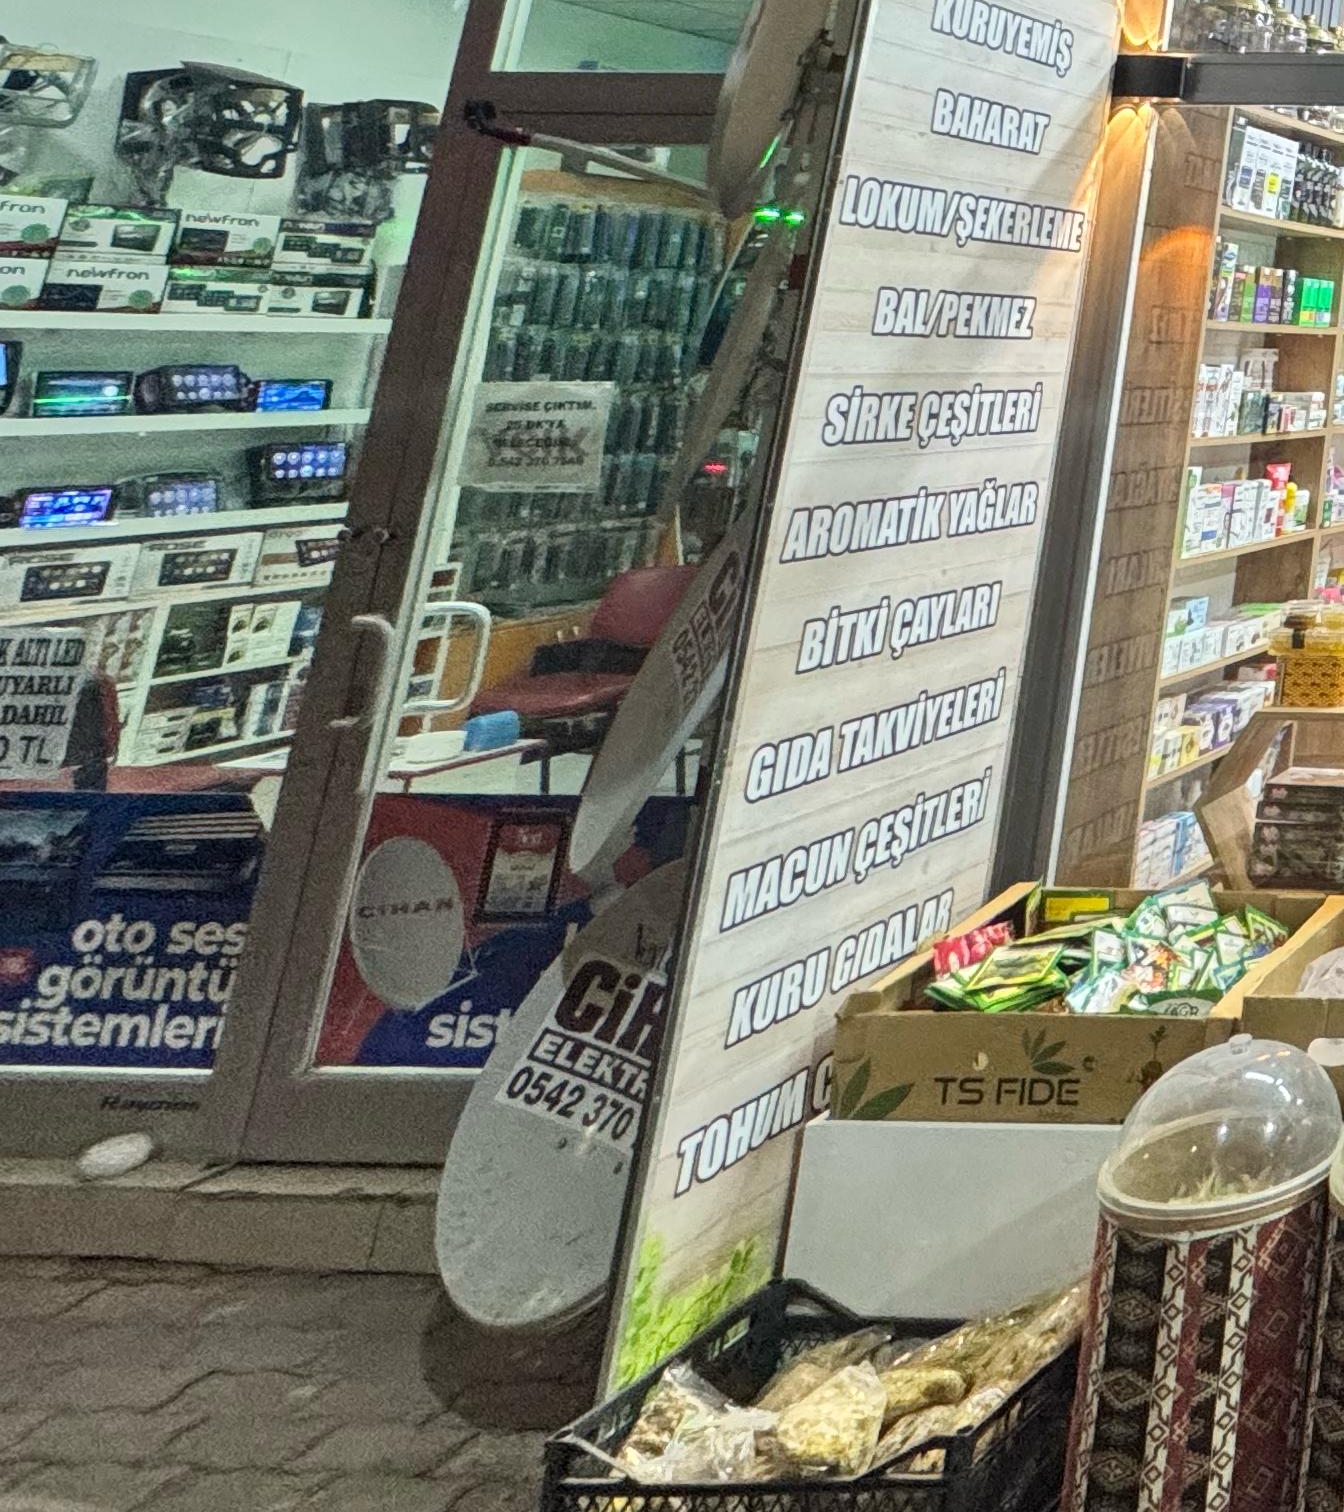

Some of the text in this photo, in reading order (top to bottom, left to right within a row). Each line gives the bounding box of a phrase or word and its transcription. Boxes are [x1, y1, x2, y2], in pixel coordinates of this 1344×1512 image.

[930, 87, 1052, 156] BAHARAT
[185, 211, 261, 229] newfron
[838, 174, 1087, 252] LOKUM/ŞEKERLEME
[66, 266, 151, 282] newfron
[872, 286, 1037, 340] BAL/PEKMEZ
[821, 381, 1045, 449] SİRKE ÇEŞİTLERİ
[779, 476, 1040, 565] AROMATİK YAĞLAR
[795, 594, 891, 676] BİTKİ
[888, 580, 1003, 661] ÇAYLARI
[744, 725, 835, 805] GIDA
[836, 666, 1007, 775] TAKVİYELERİ
[720, 826, 857, 935] MACUN
[852, 764, 994, 885] ÇEŞİTLERİ
[71, 912, 251, 956] oto ses
[34, 953, 239, 1010] görüntü
[724, 945, 832, 1051] KURU
[505, 1065, 638, 1143] 0542 370
[934, 1076, 1081, 1107] TS FIDE
[673, 1065, 811, 1199] TOHUM
